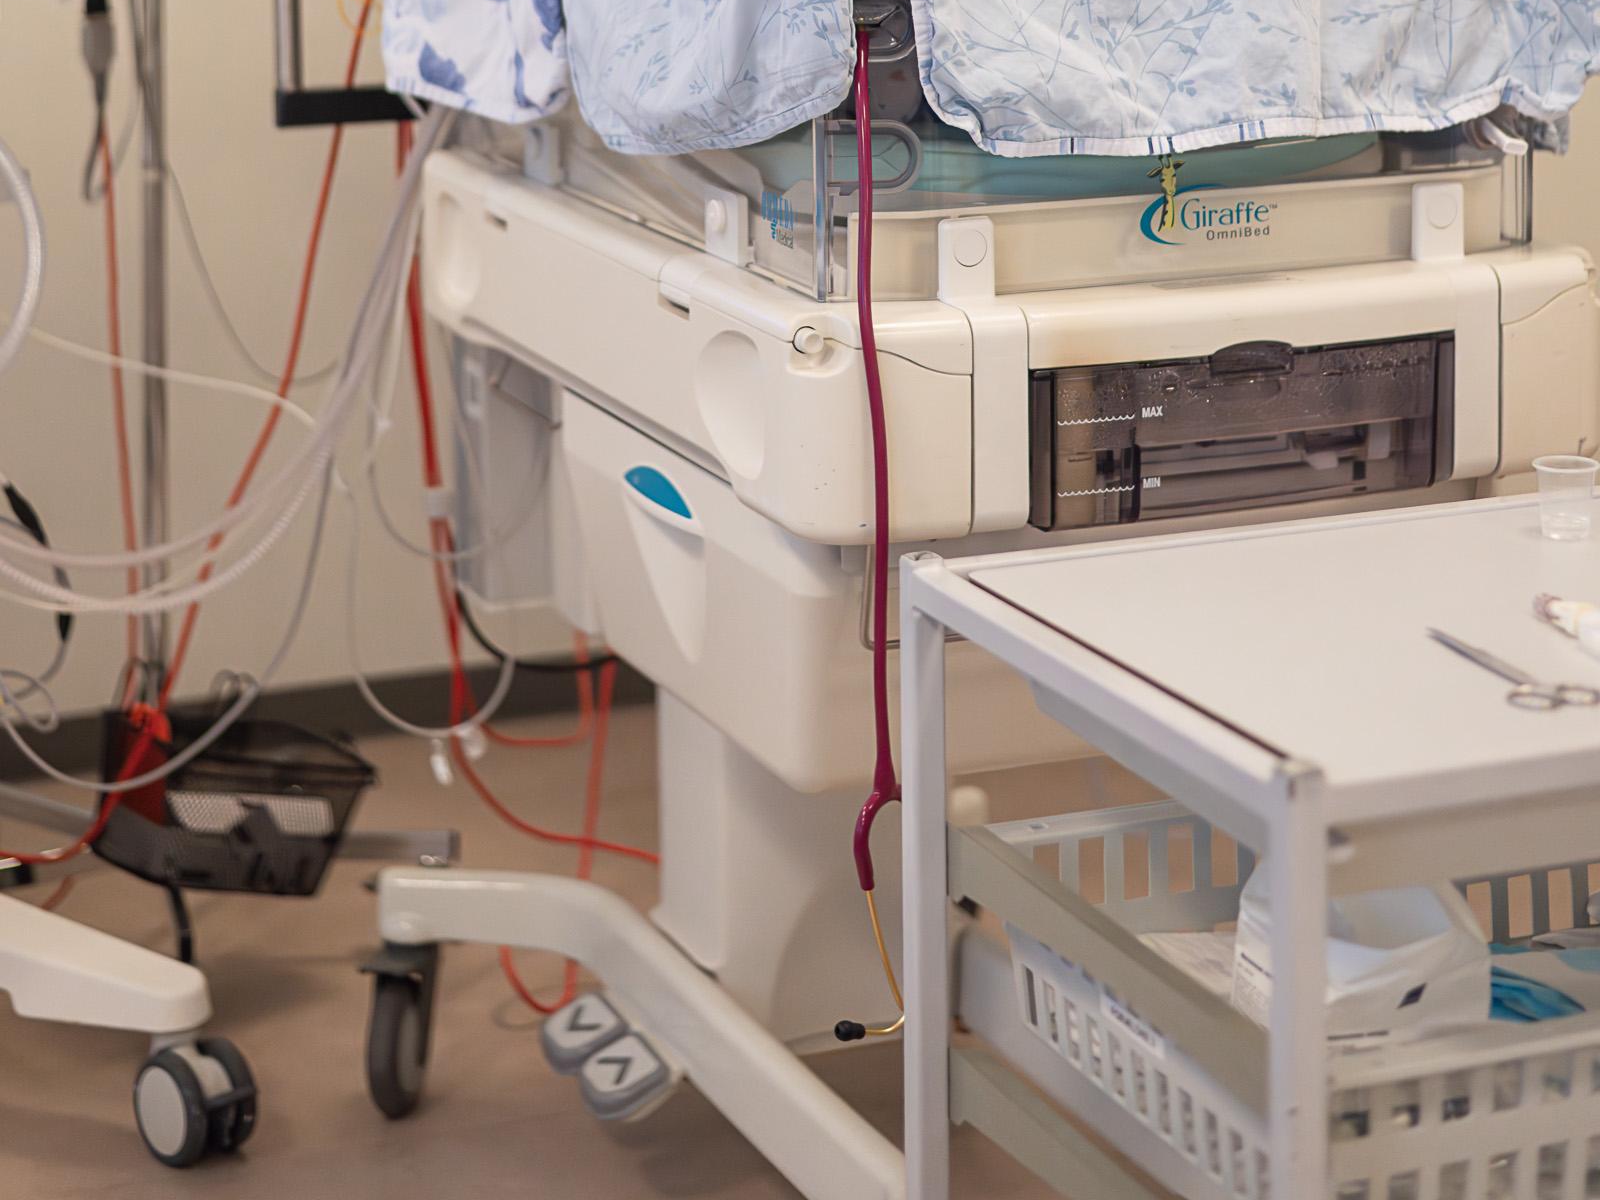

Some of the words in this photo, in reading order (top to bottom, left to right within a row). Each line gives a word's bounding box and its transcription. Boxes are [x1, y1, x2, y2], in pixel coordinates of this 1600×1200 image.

[1206, 225, 1270, 241] OmniBed
[1141, 405, 1163, 418] MAX
[1142, 476, 1161, 489] MIN
